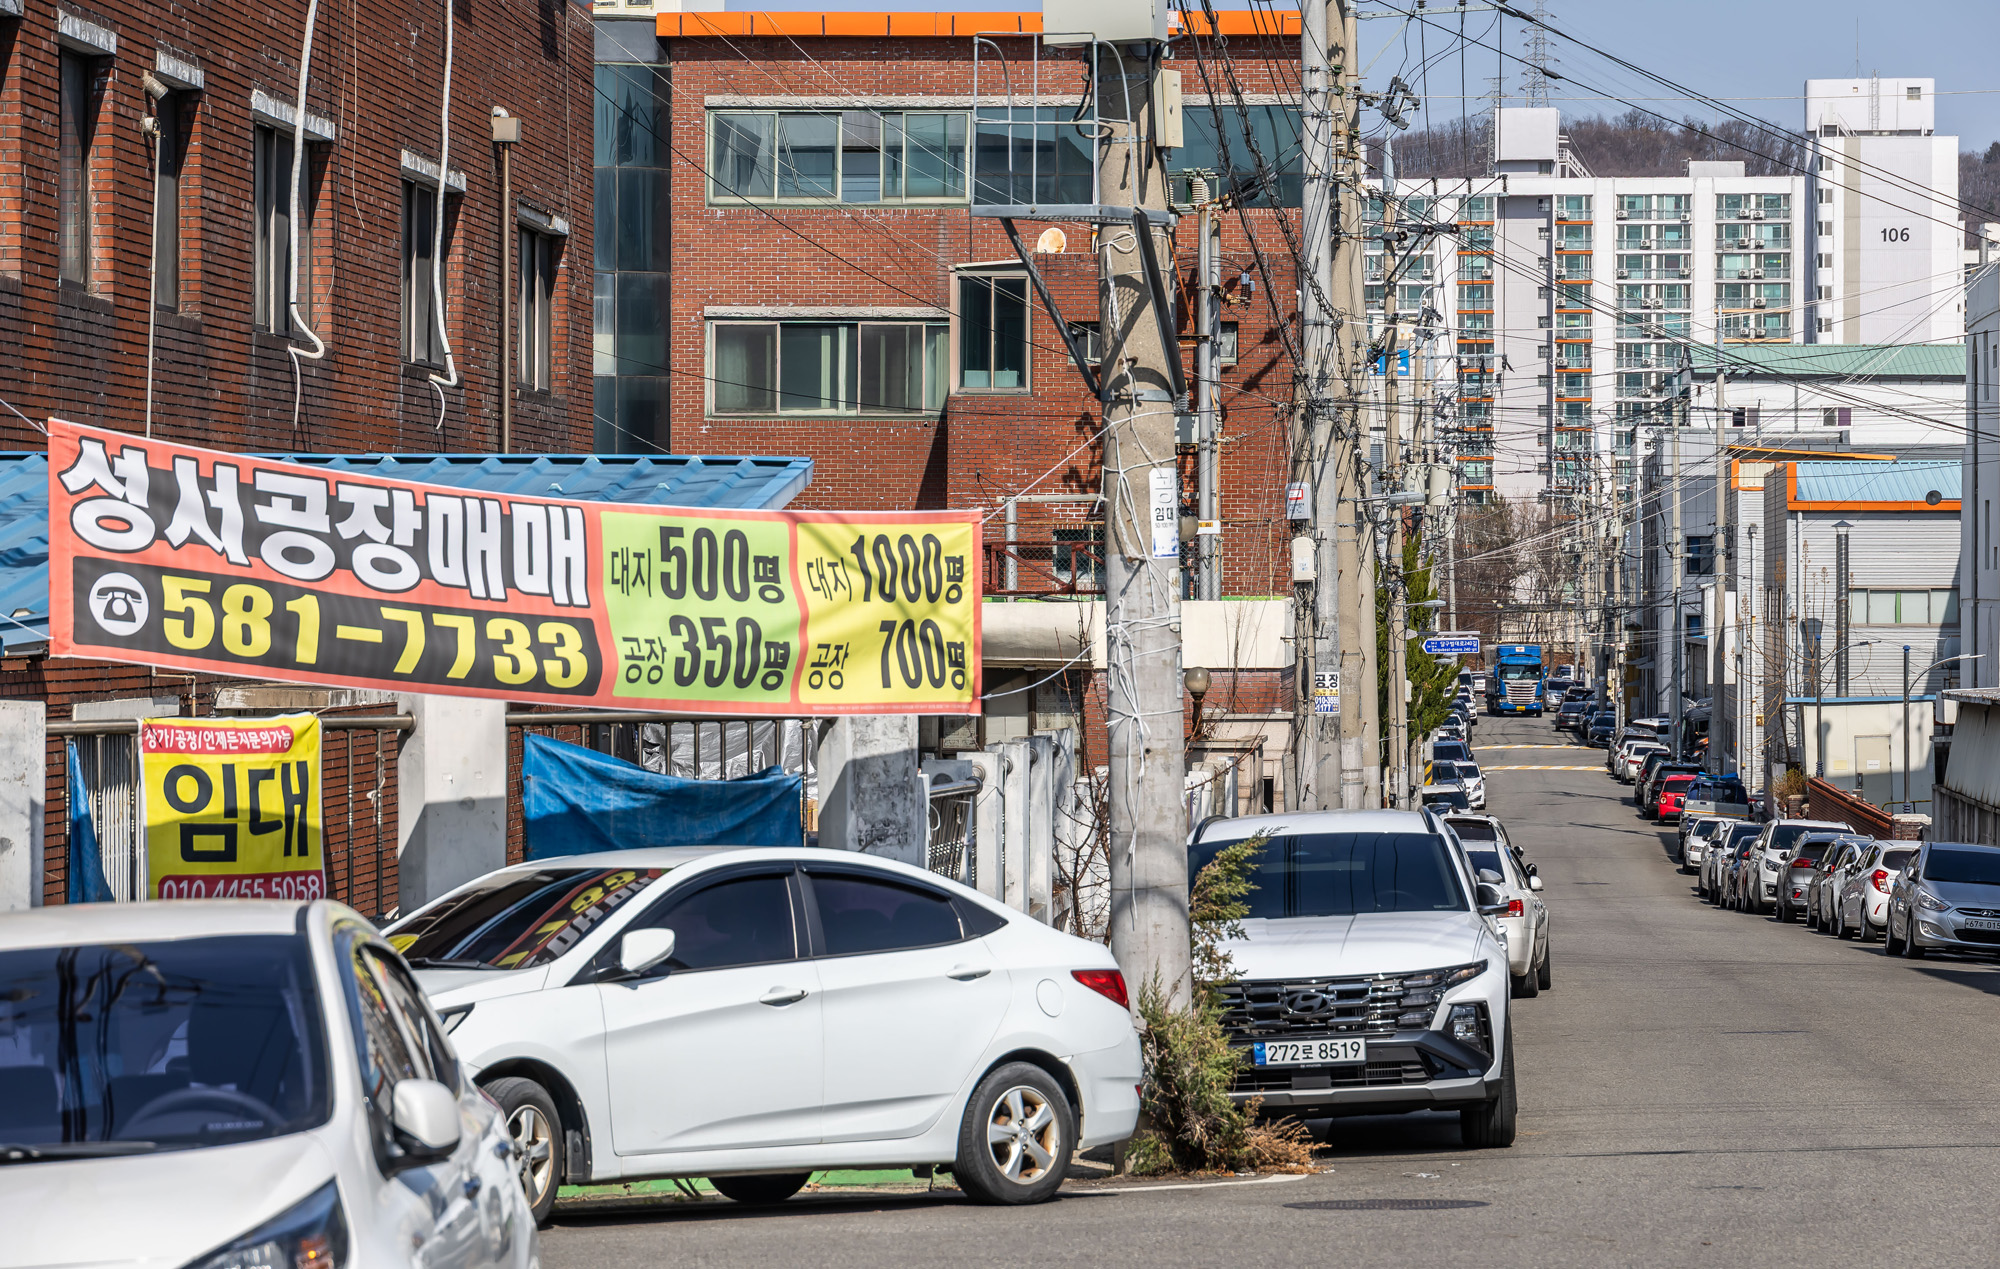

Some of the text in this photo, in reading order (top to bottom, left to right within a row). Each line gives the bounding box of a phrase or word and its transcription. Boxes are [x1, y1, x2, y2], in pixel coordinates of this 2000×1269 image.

[1881, 227, 1910, 242] 106
[59, 437, 590, 607] 성서공장매매
[611, 526, 785, 604] 대지 500평
[806, 533, 964, 604] 대지 1000평
[161, 575, 588, 689] 581-7733
[624, 614, 790, 690] 공장 350평
[808, 619, 965, 690] 공장 700평
[163, 760, 309, 862] 임대
[1268, 1041, 1361, 1062] 272로 8519
